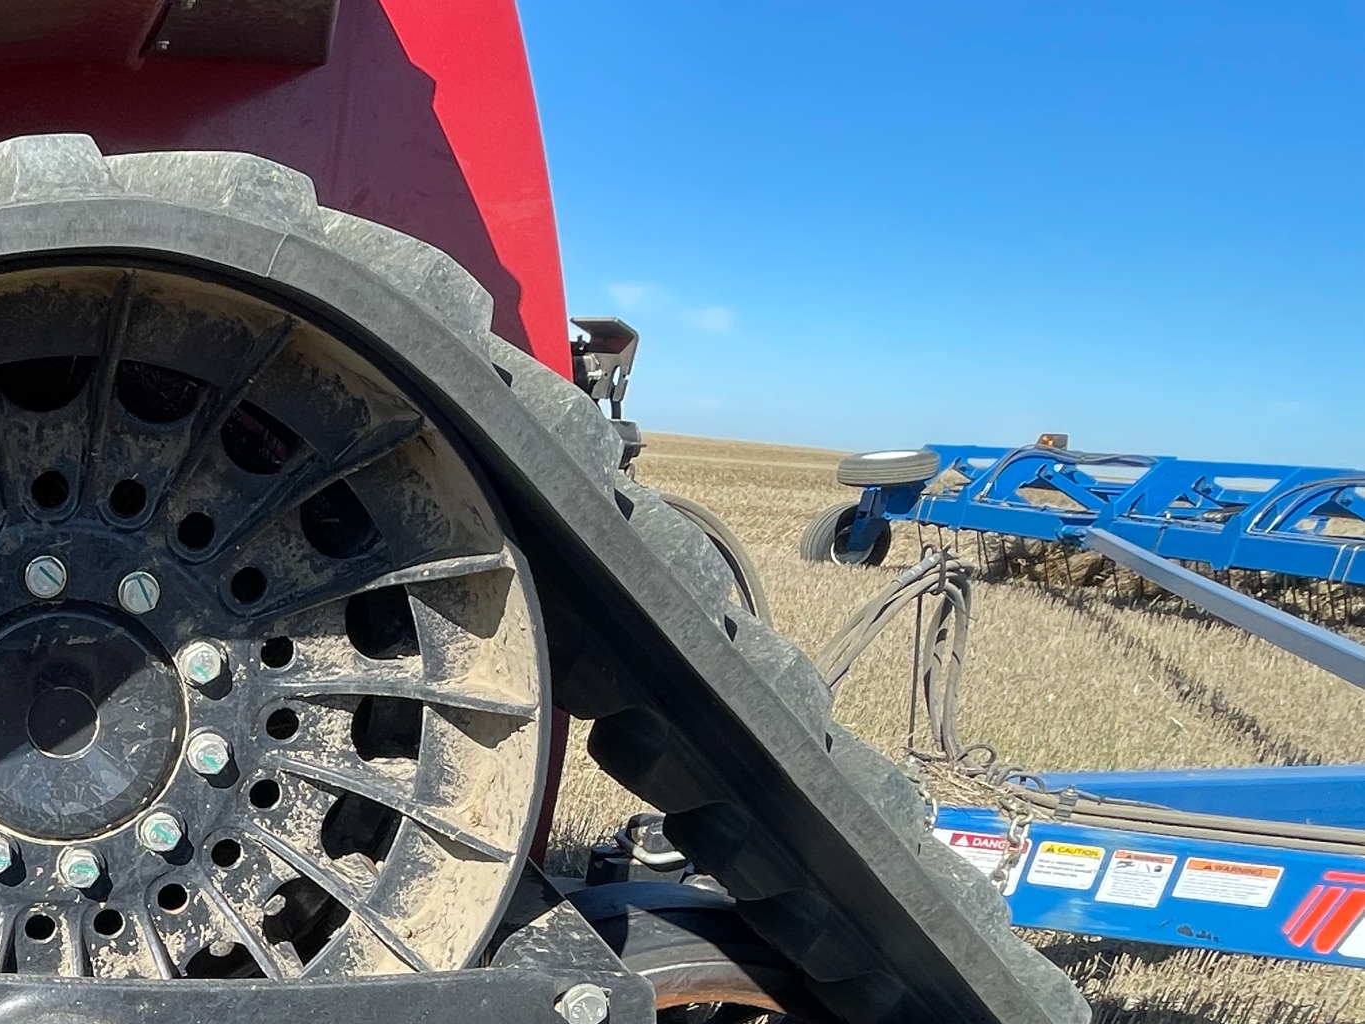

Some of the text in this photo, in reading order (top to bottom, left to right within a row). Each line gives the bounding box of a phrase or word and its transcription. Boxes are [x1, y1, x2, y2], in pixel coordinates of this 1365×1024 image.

[972, 837, 1016, 851] DANG
[1057, 846, 1099, 856] CAUTION
[1215, 864, 1263, 876] WARNING
